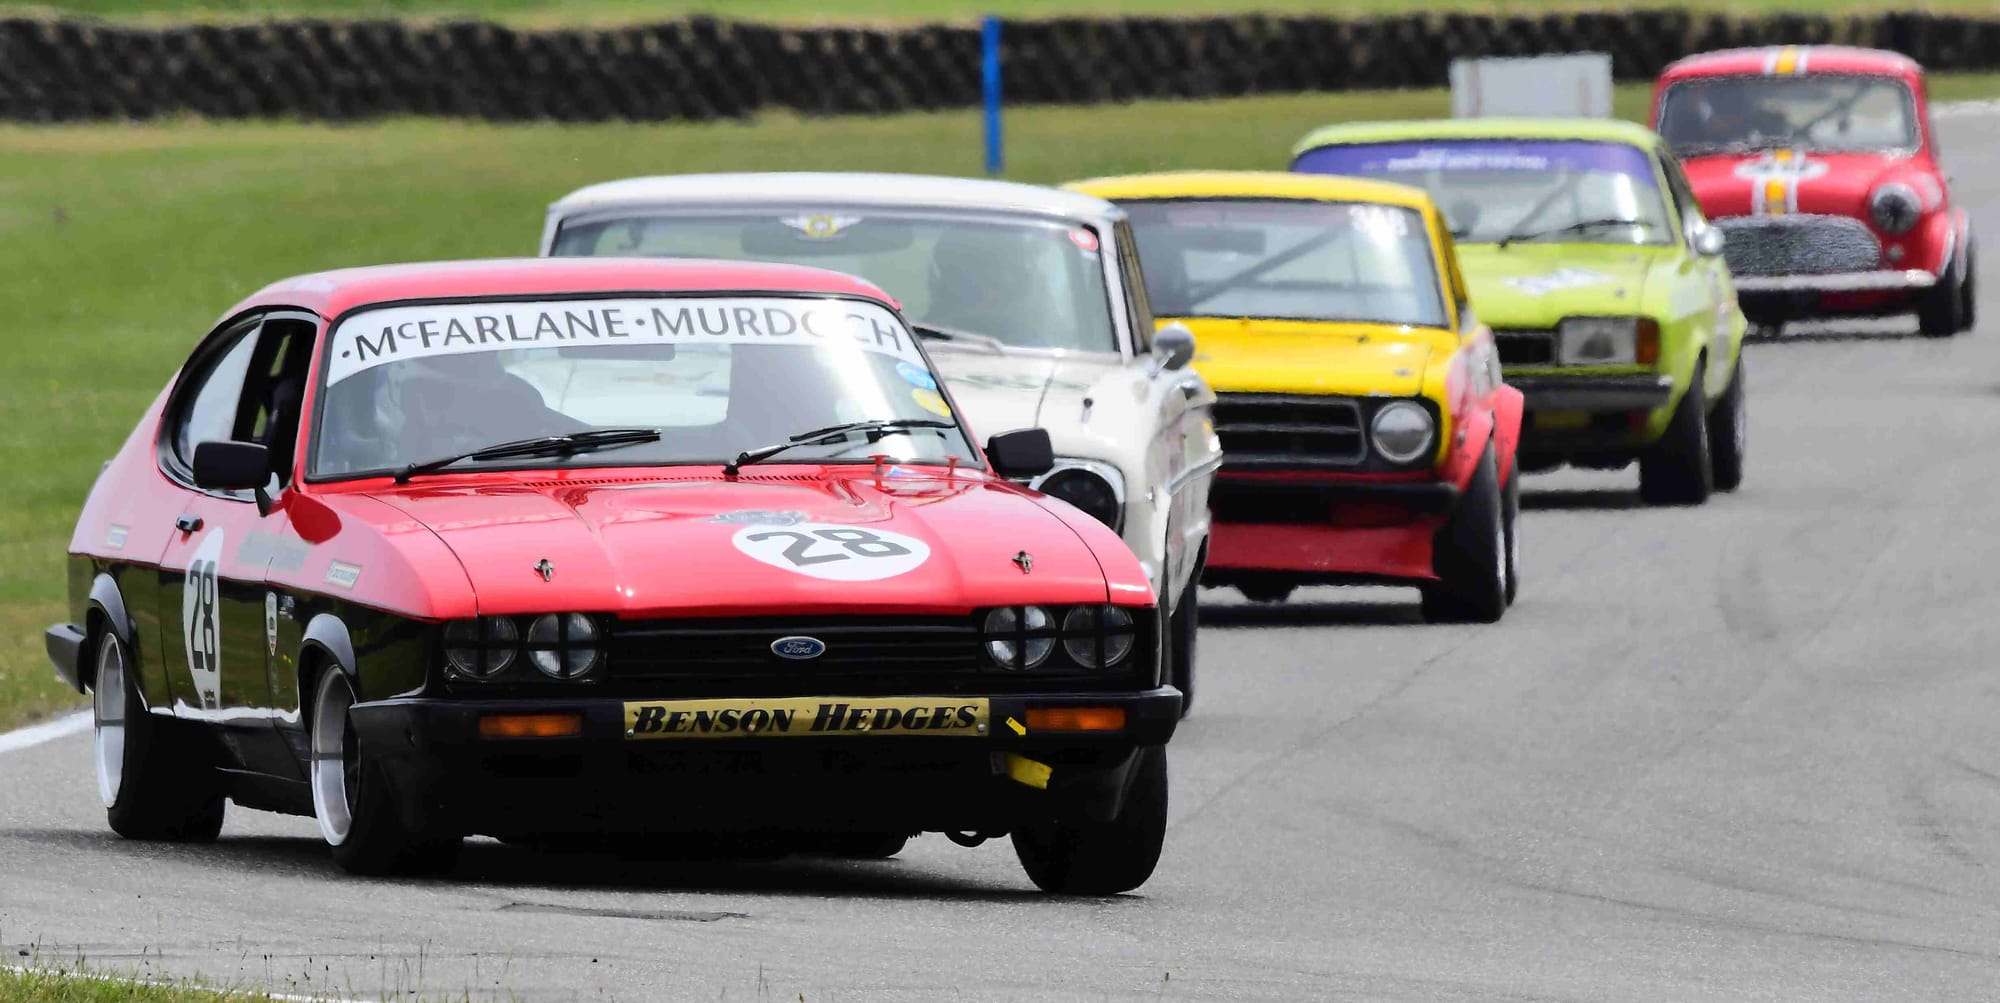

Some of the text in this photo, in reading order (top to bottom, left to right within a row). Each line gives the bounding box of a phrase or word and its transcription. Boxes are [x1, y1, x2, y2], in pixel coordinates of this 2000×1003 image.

[746, 528, 912, 567] 28
[189, 559, 216, 673] 28
[783, 640, 813, 656] Ford
[635, 702, 979, 734] BENSON HEDGES
